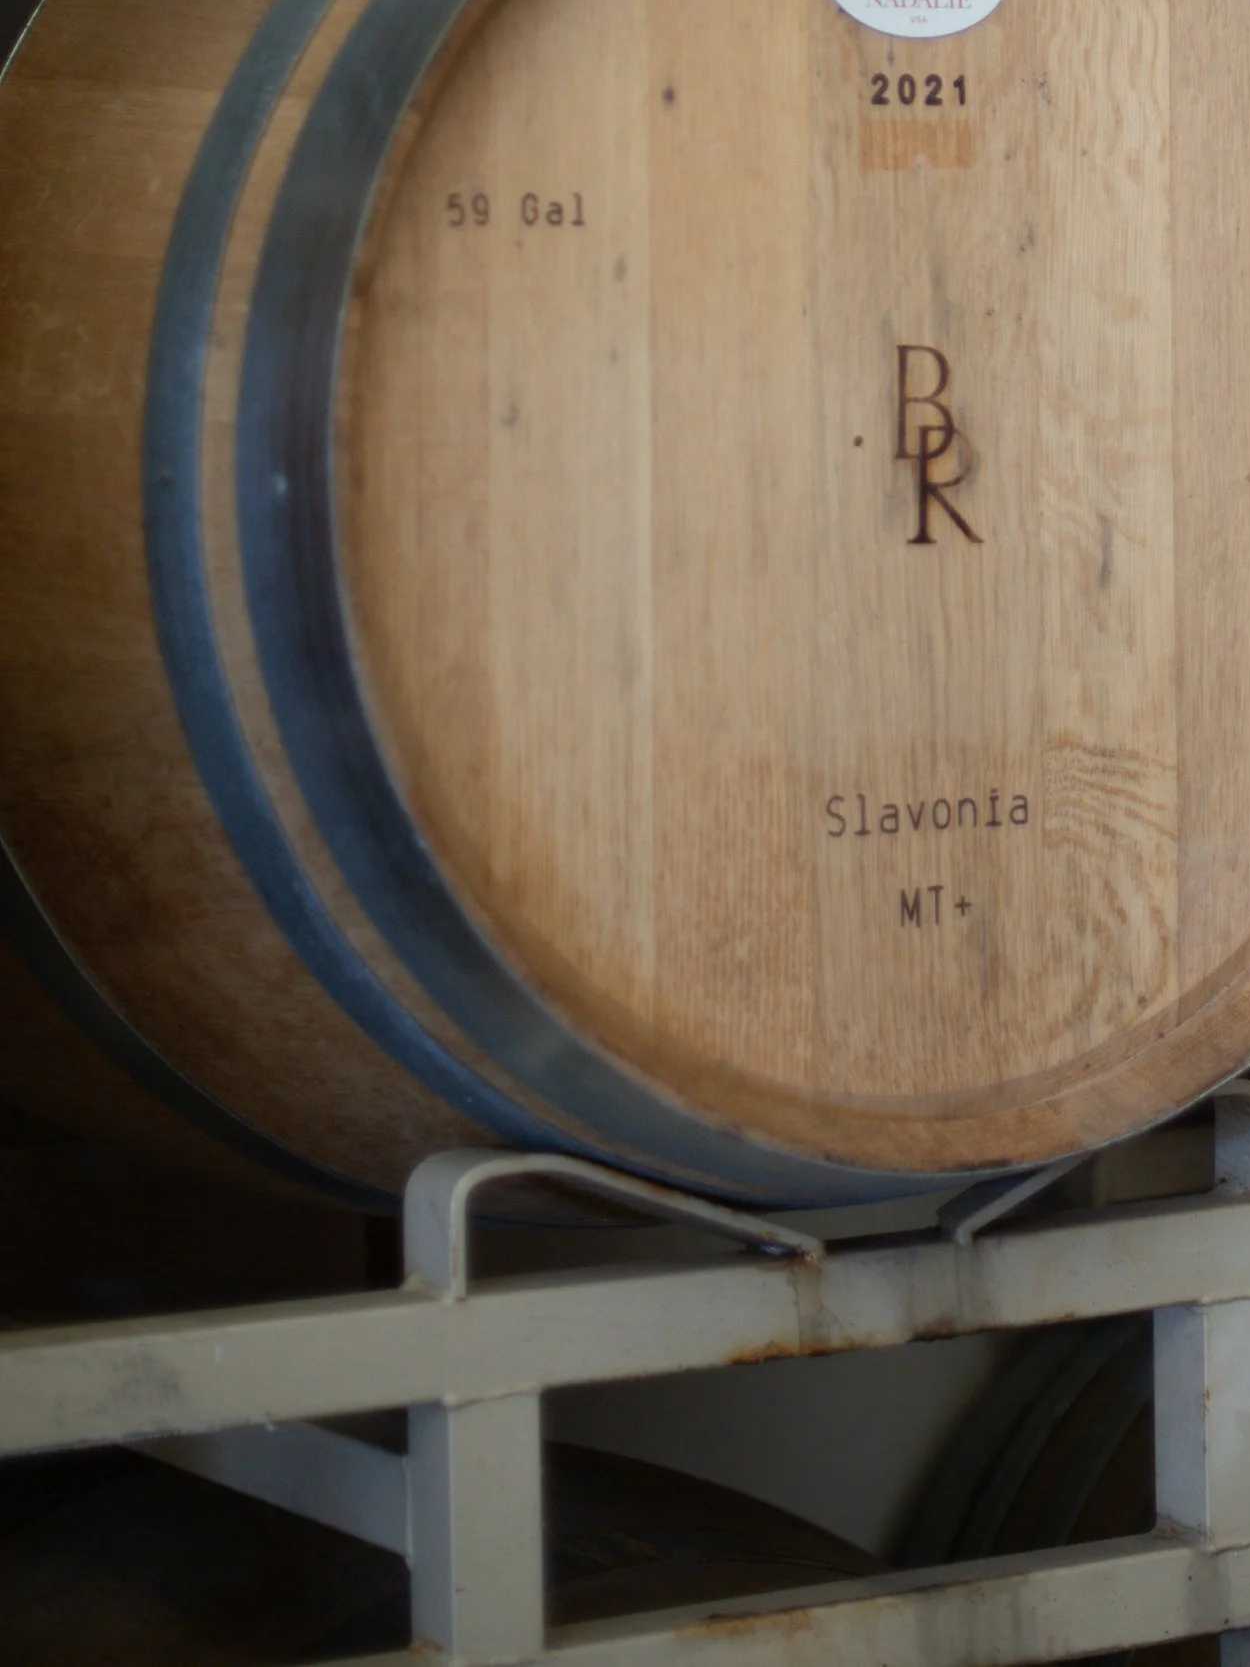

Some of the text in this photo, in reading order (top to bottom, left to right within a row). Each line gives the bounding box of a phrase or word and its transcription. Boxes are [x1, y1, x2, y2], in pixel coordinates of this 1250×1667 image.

[870, 72, 967, 106] 2021
[446, 192, 585, 227] 59 Gal
[826, 788, 1029, 838] Slavonia
